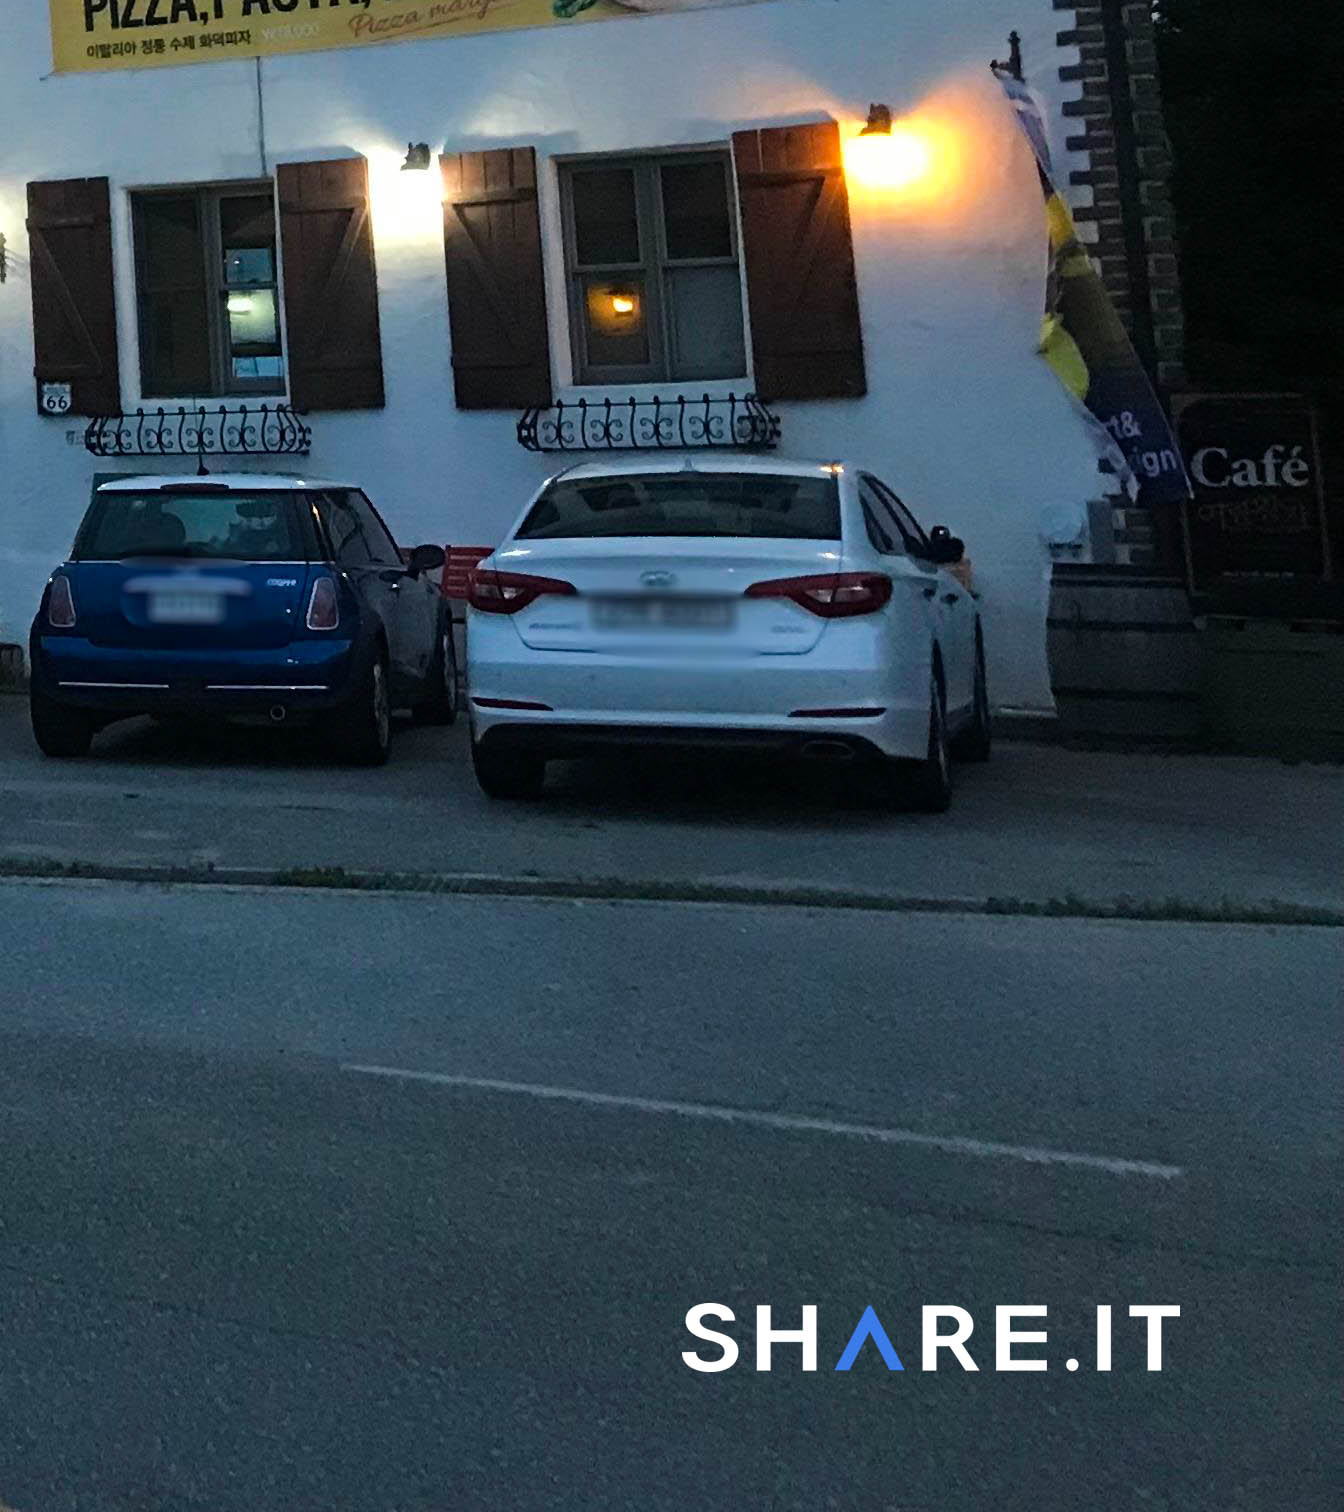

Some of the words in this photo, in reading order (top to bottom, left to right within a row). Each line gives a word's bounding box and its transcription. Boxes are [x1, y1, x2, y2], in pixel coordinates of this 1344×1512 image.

[349, 9, 419, 38] Pizza
[141, 39, 166, 55] 정통
[170, 35, 196, 52] 수제
[46, 395, 68, 410] 66
[1190, 444, 1310, 488] Café
